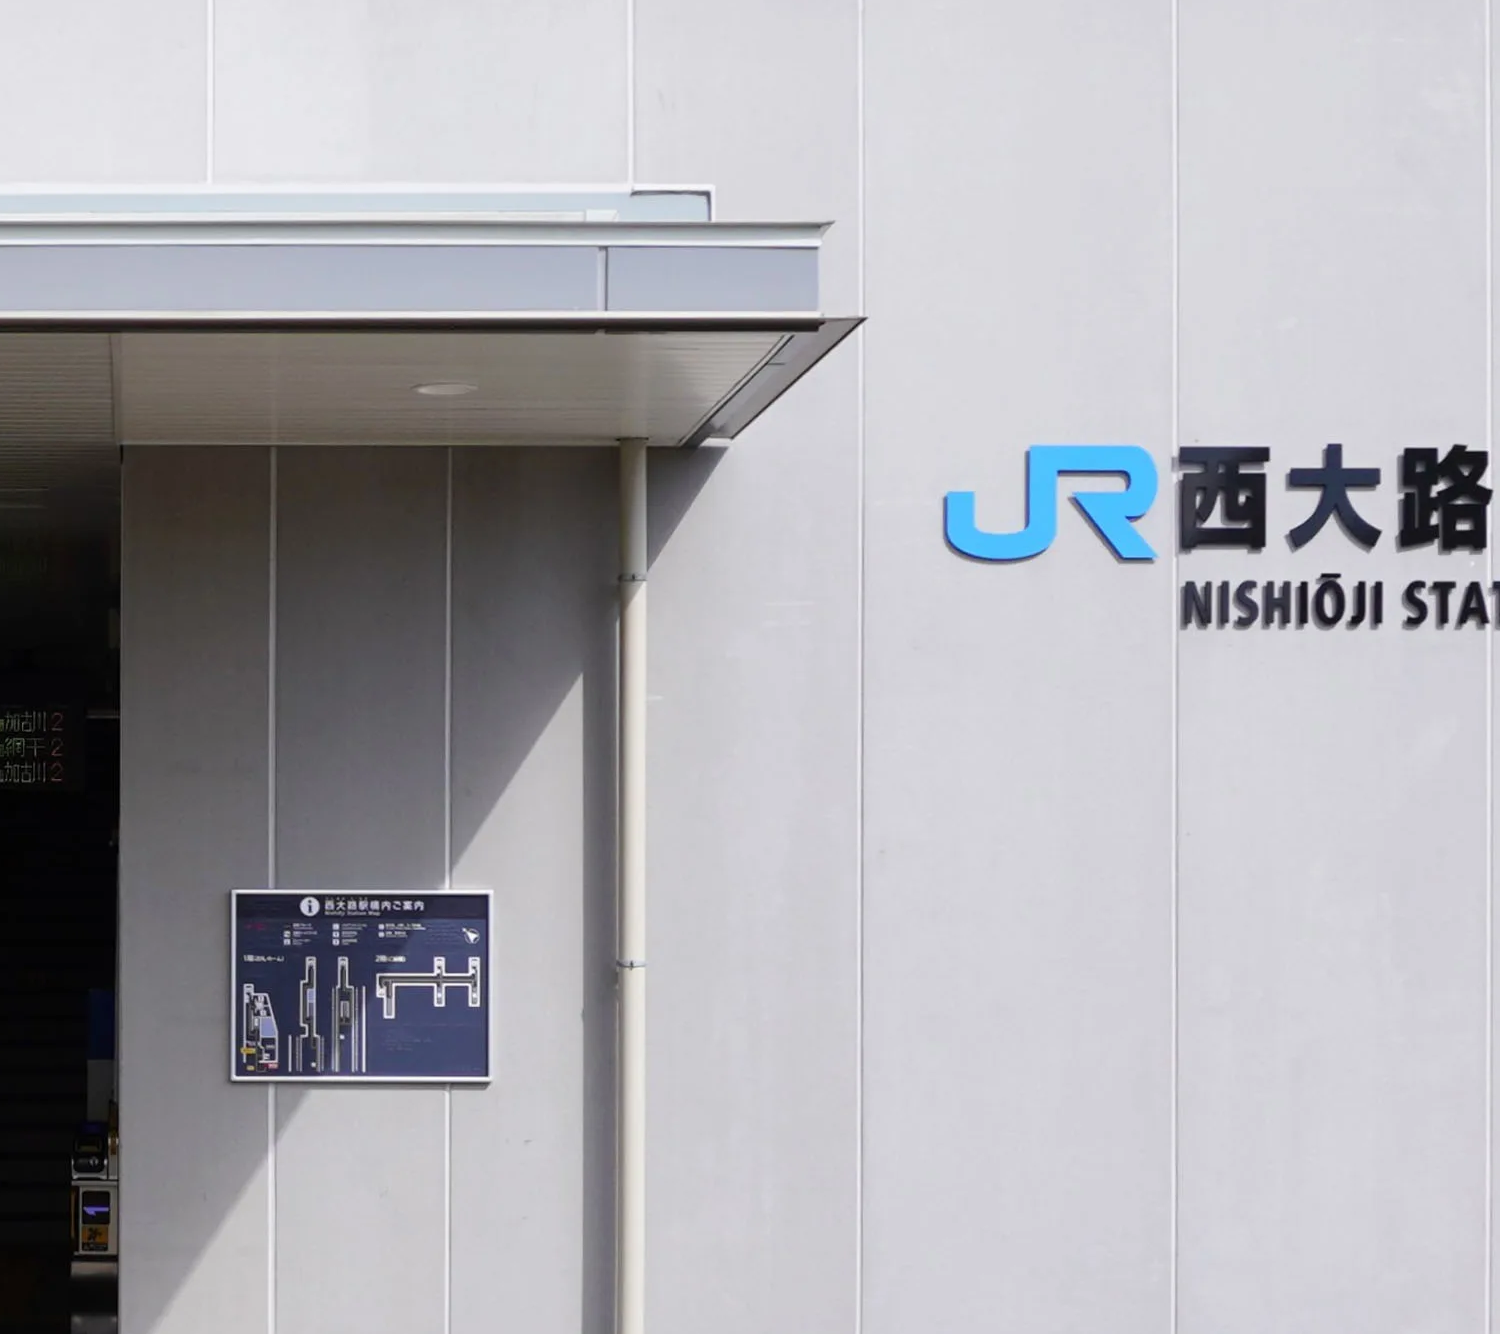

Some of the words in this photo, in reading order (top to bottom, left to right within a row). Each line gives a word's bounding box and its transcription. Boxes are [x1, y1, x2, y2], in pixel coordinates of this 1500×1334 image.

[944, 445, 1158, 562] JR
[1181, 573, 1383, 628] NISHIŌJI
[50, 711, 64, 732] 2
[50, 737, 64, 757] 2
[50, 762, 64, 782] 2
